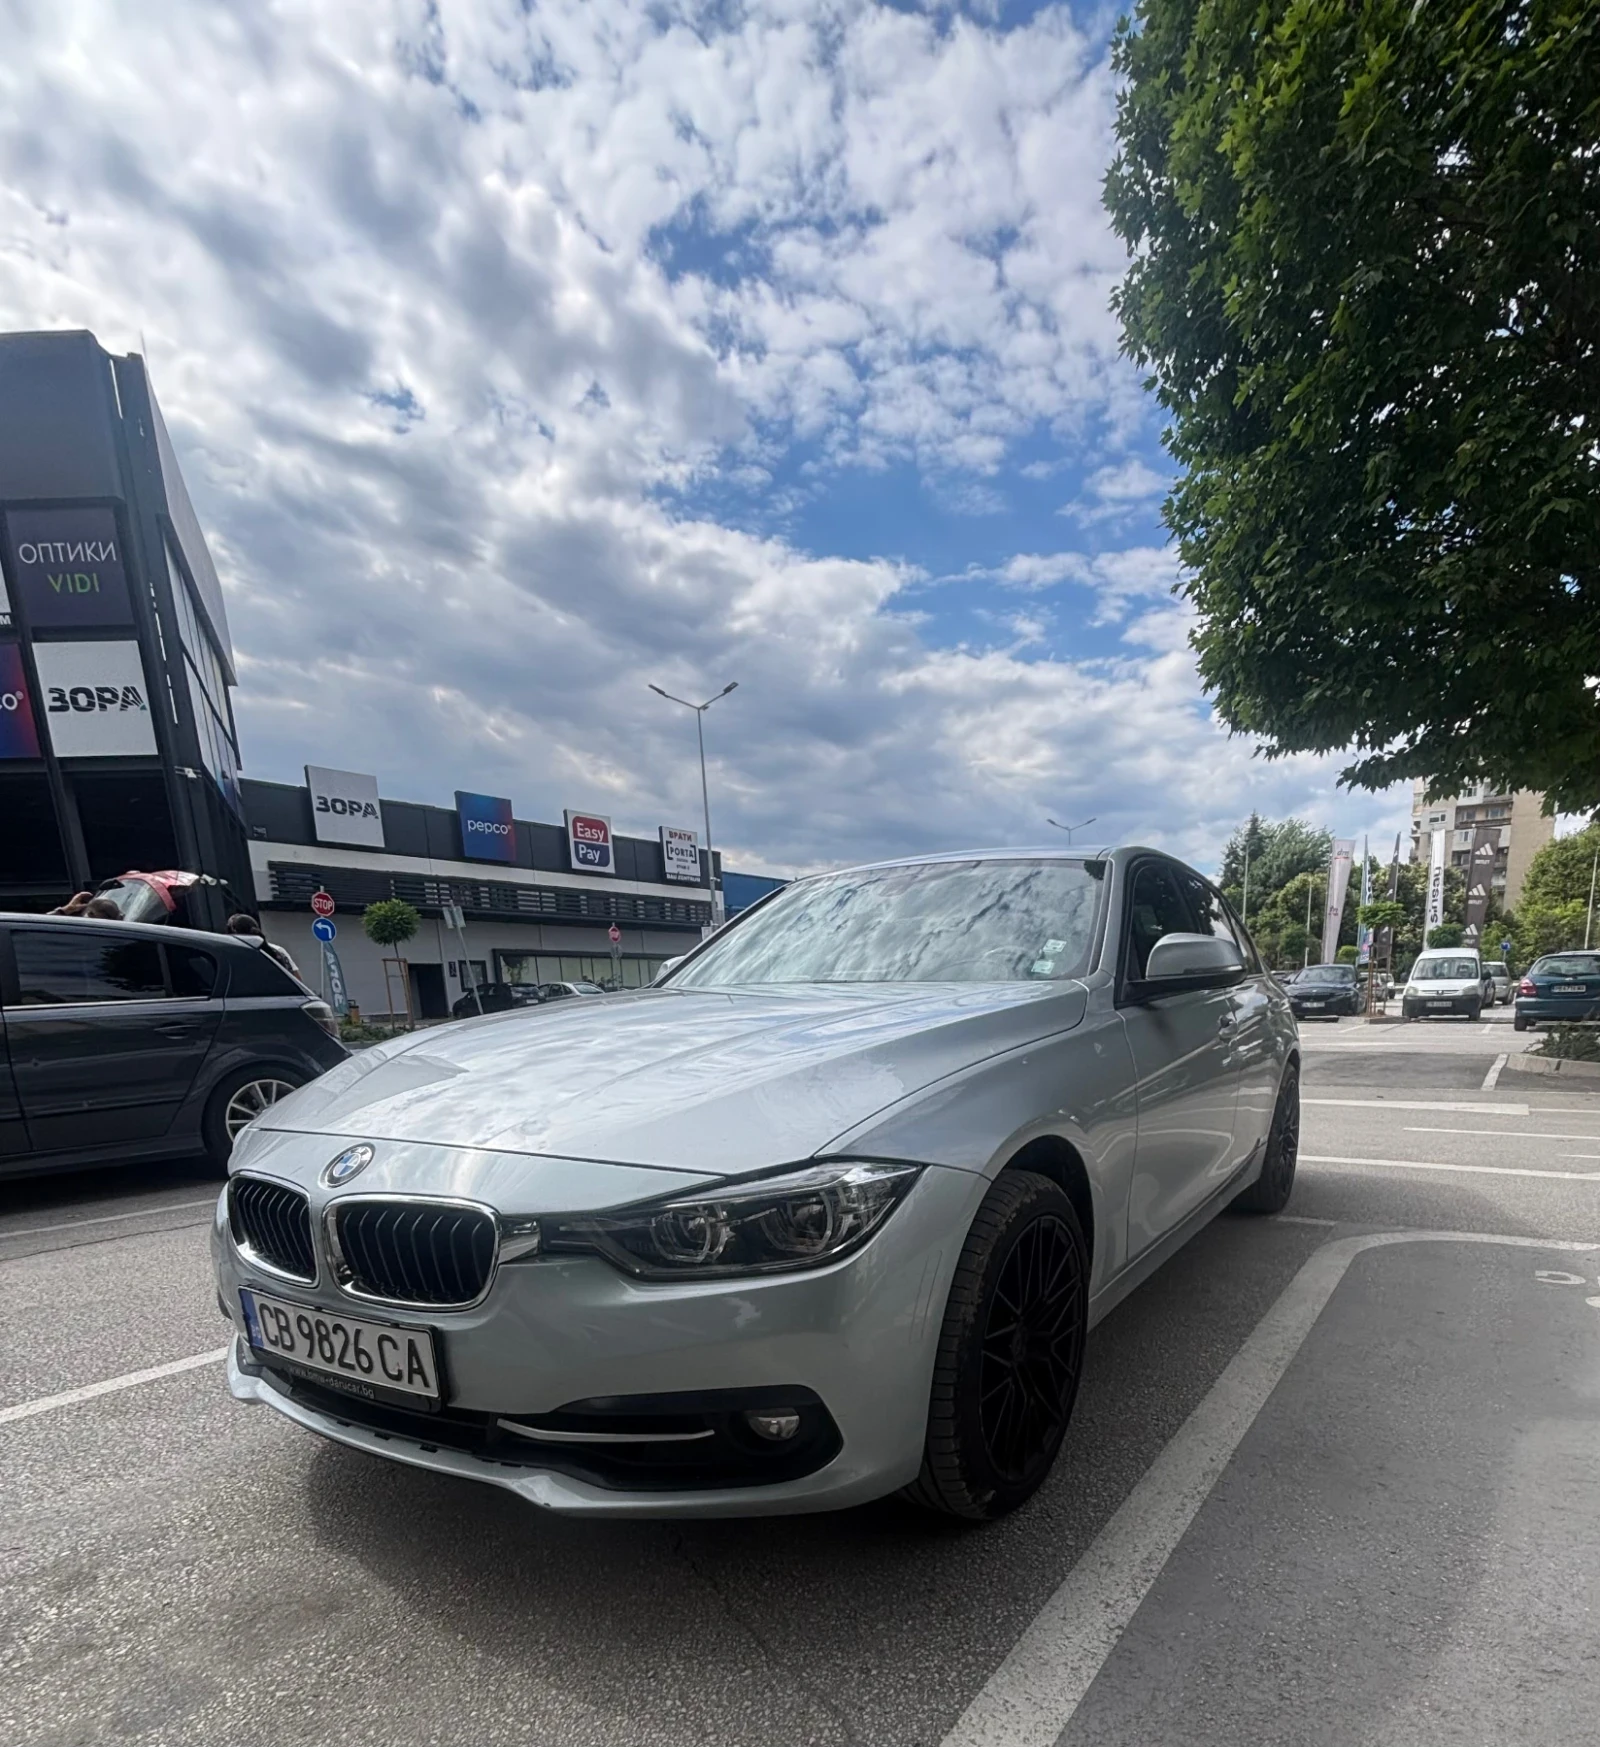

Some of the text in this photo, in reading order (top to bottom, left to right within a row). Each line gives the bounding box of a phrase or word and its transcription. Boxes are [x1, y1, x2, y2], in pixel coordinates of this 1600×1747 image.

[19, 541, 116, 564] ОПТИКИ
[47, 572, 99, 593] VIDI
[48, 685, 147, 713] ЗОРА
[316, 795, 379, 819] ЗОРА
[467, 819, 509, 835] pepco
[576, 822, 604, 842] Easy
[668, 830, 692, 841] ВРАТИ
[578, 844, 600, 863] Pay
[670, 846, 694, 858] PORTA
[314, 898, 333, 911] STOP
[1429, 866, 1442, 924] sinsay
[258, 1302, 431, 1389] CB 9826 CA
